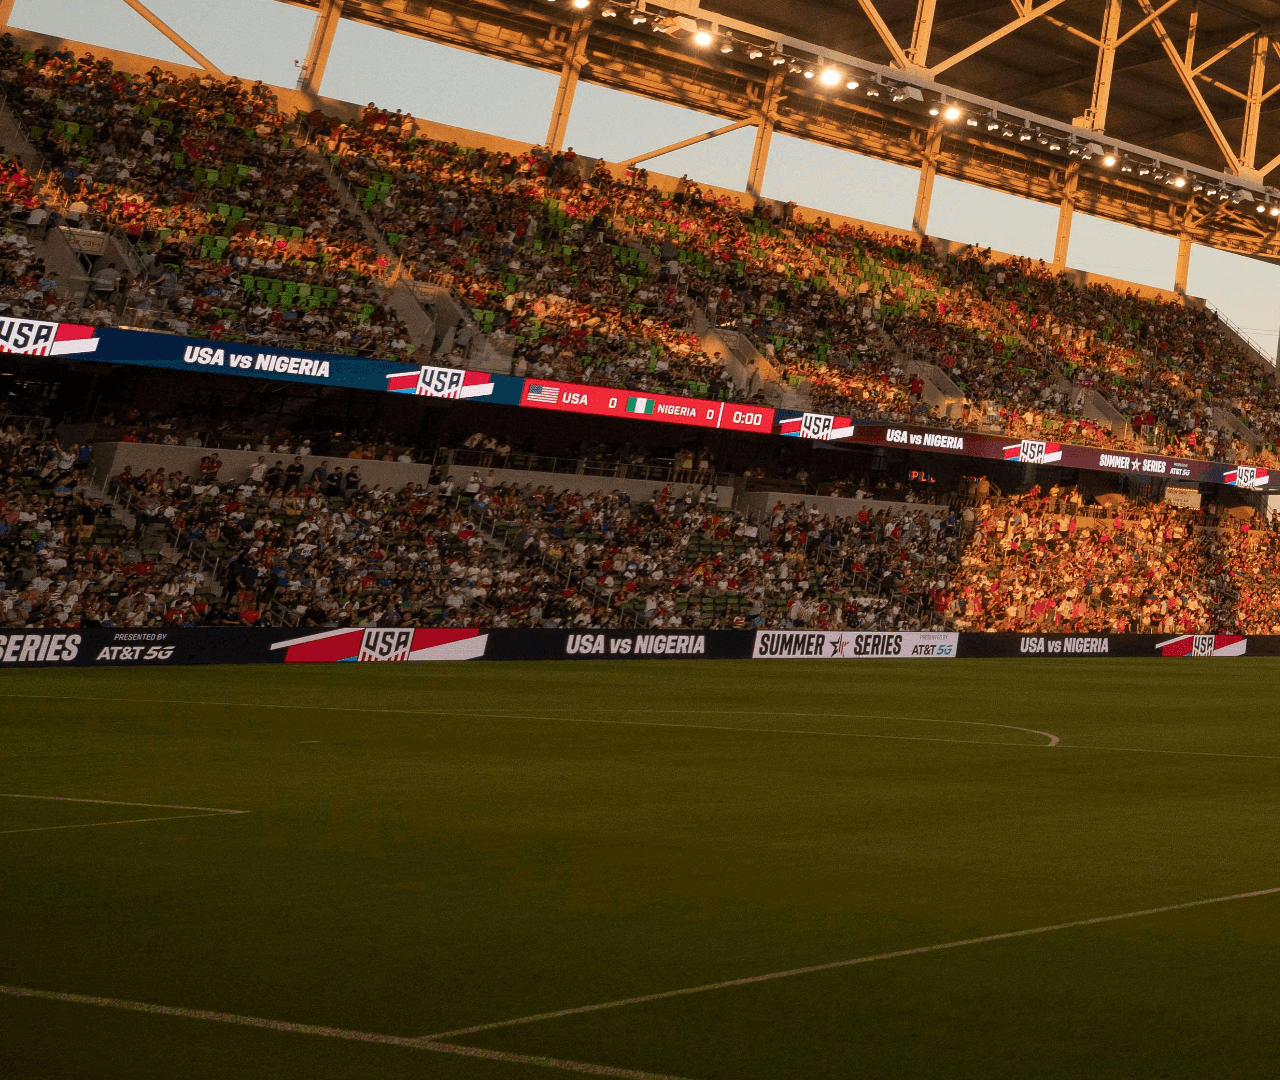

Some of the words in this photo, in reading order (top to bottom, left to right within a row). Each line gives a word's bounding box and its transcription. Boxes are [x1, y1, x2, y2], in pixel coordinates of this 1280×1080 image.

[183, 345, 225, 366] USA
[229, 353, 253, 368] vs
[254, 353, 330, 378] NIGERIA
[422, 369, 460, 393] USA
[562, 392, 588, 406] USA
[608, 397, 618, 409] 0
[657, 404, 696, 418] NIGERIA
[706, 409, 715, 420] 0
[732, 411, 762, 426] 0:00
[804, 417, 831, 435] USA
[886, 429, 908, 444] USA
[909, 433, 923, 445] vs
[922, 434, 964, 450] NIGERIA
[1022, 443, 1044, 460] USA
[1099, 453, 1130, 470] SUMMER
[1142, 459, 1167, 474] SERIES
[1170, 467, 1182, 475] AT&T
[1238, 468, 1255, 484] USA
[114, 633, 155, 641] PRESENTED
[156, 633, 168, 641] BY
[365, 631, 410, 656] USA
[566, 634, 605, 654] USA
[610, 638, 632, 654] vs
[634, 635, 705, 654] NIGERIA
[759, 633, 825, 655] SUMMER
[853, 634, 903, 655] SERIES
[1020, 637, 1045, 653] USA
[1047, 641, 1062, 653] vs
[1063, 638, 1109, 653] NIGERIA
[1195, 636, 1213, 653] USA
[96, 646, 144, 660] AT&T
[143, 645, 175, 660] 5G
[912, 644, 936, 655] AT&T
[936, 644, 953, 655] 5G
